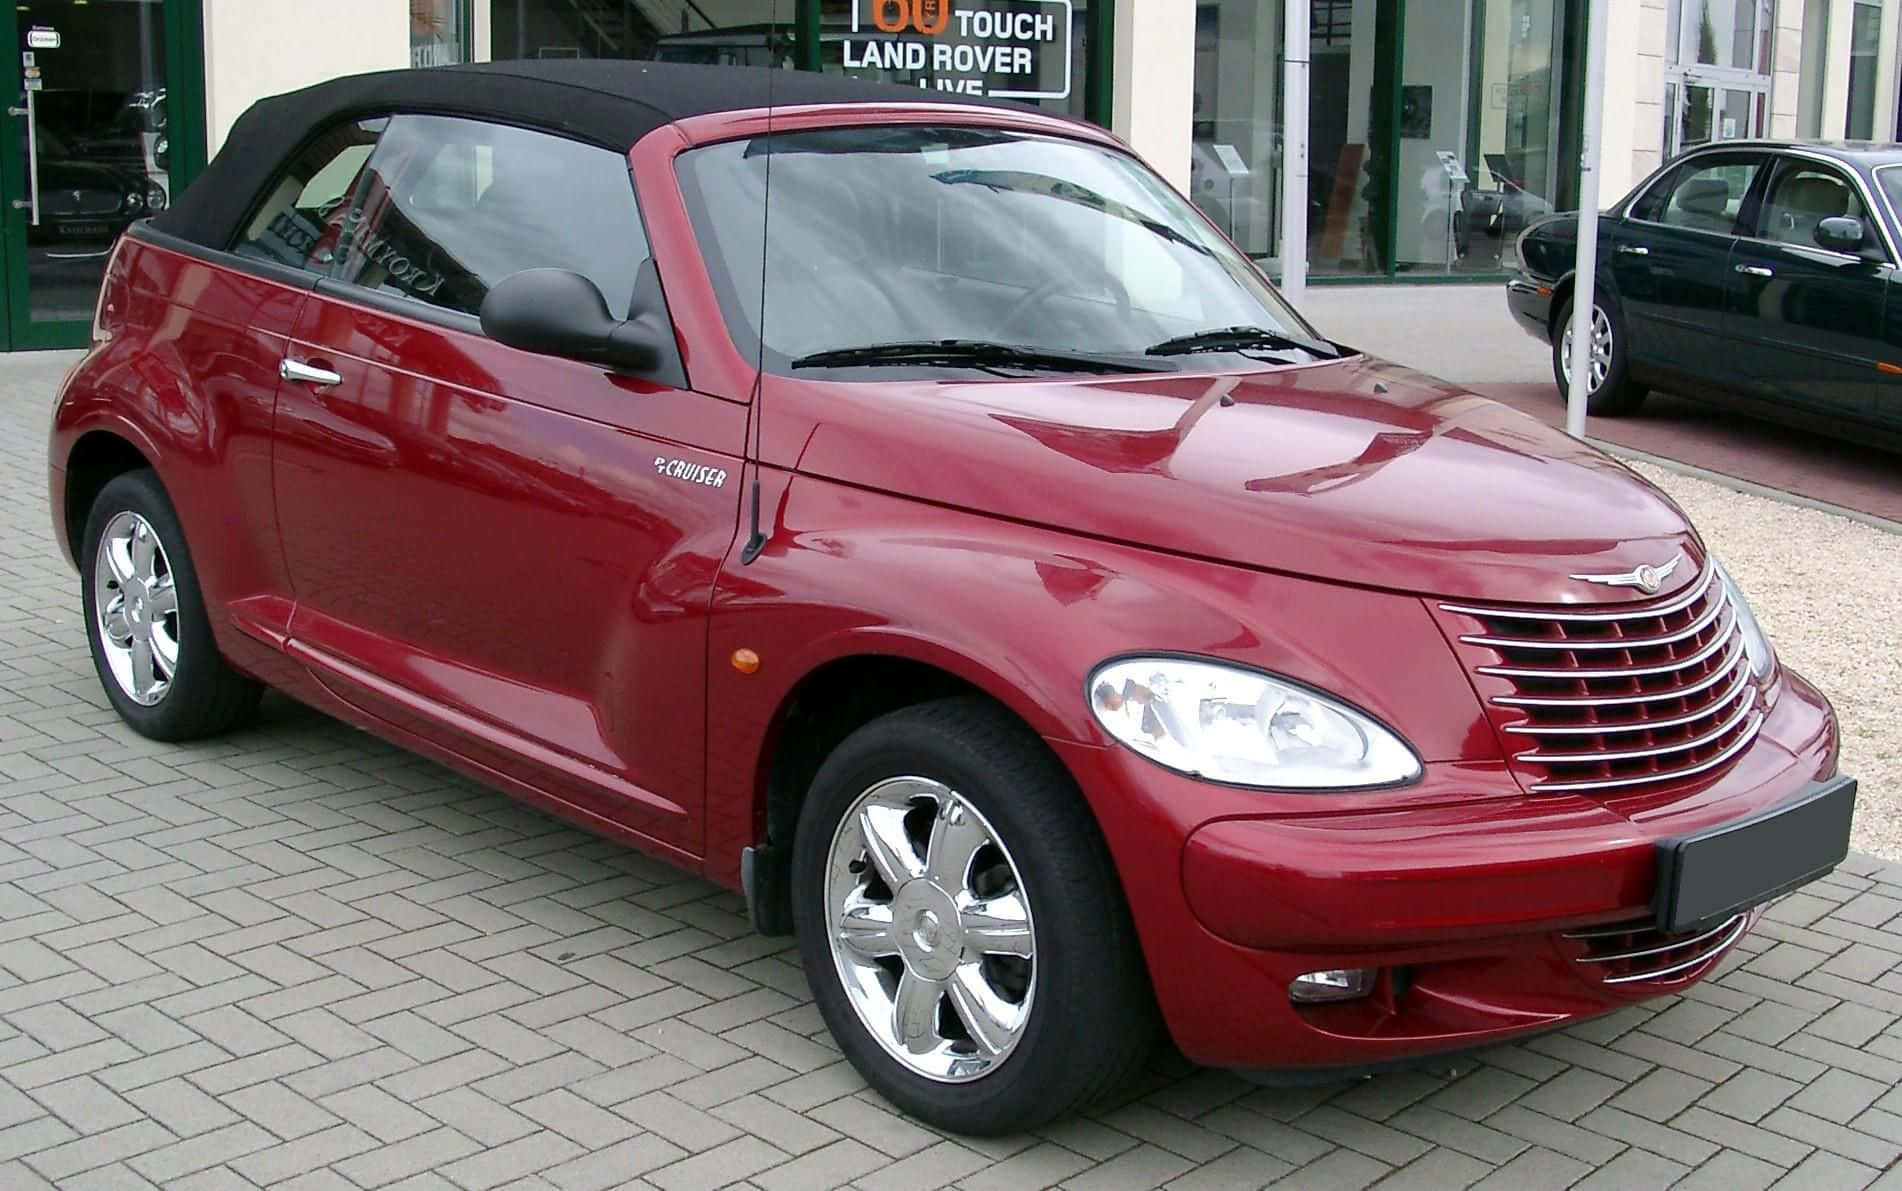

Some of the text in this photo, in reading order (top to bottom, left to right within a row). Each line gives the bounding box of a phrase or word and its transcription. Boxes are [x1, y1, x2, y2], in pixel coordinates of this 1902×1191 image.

[954, 10, 1053, 41] TOUCH
[843, 40, 1032, 74] LAND ROVER
[665, 459, 727, 488] CRUISER
